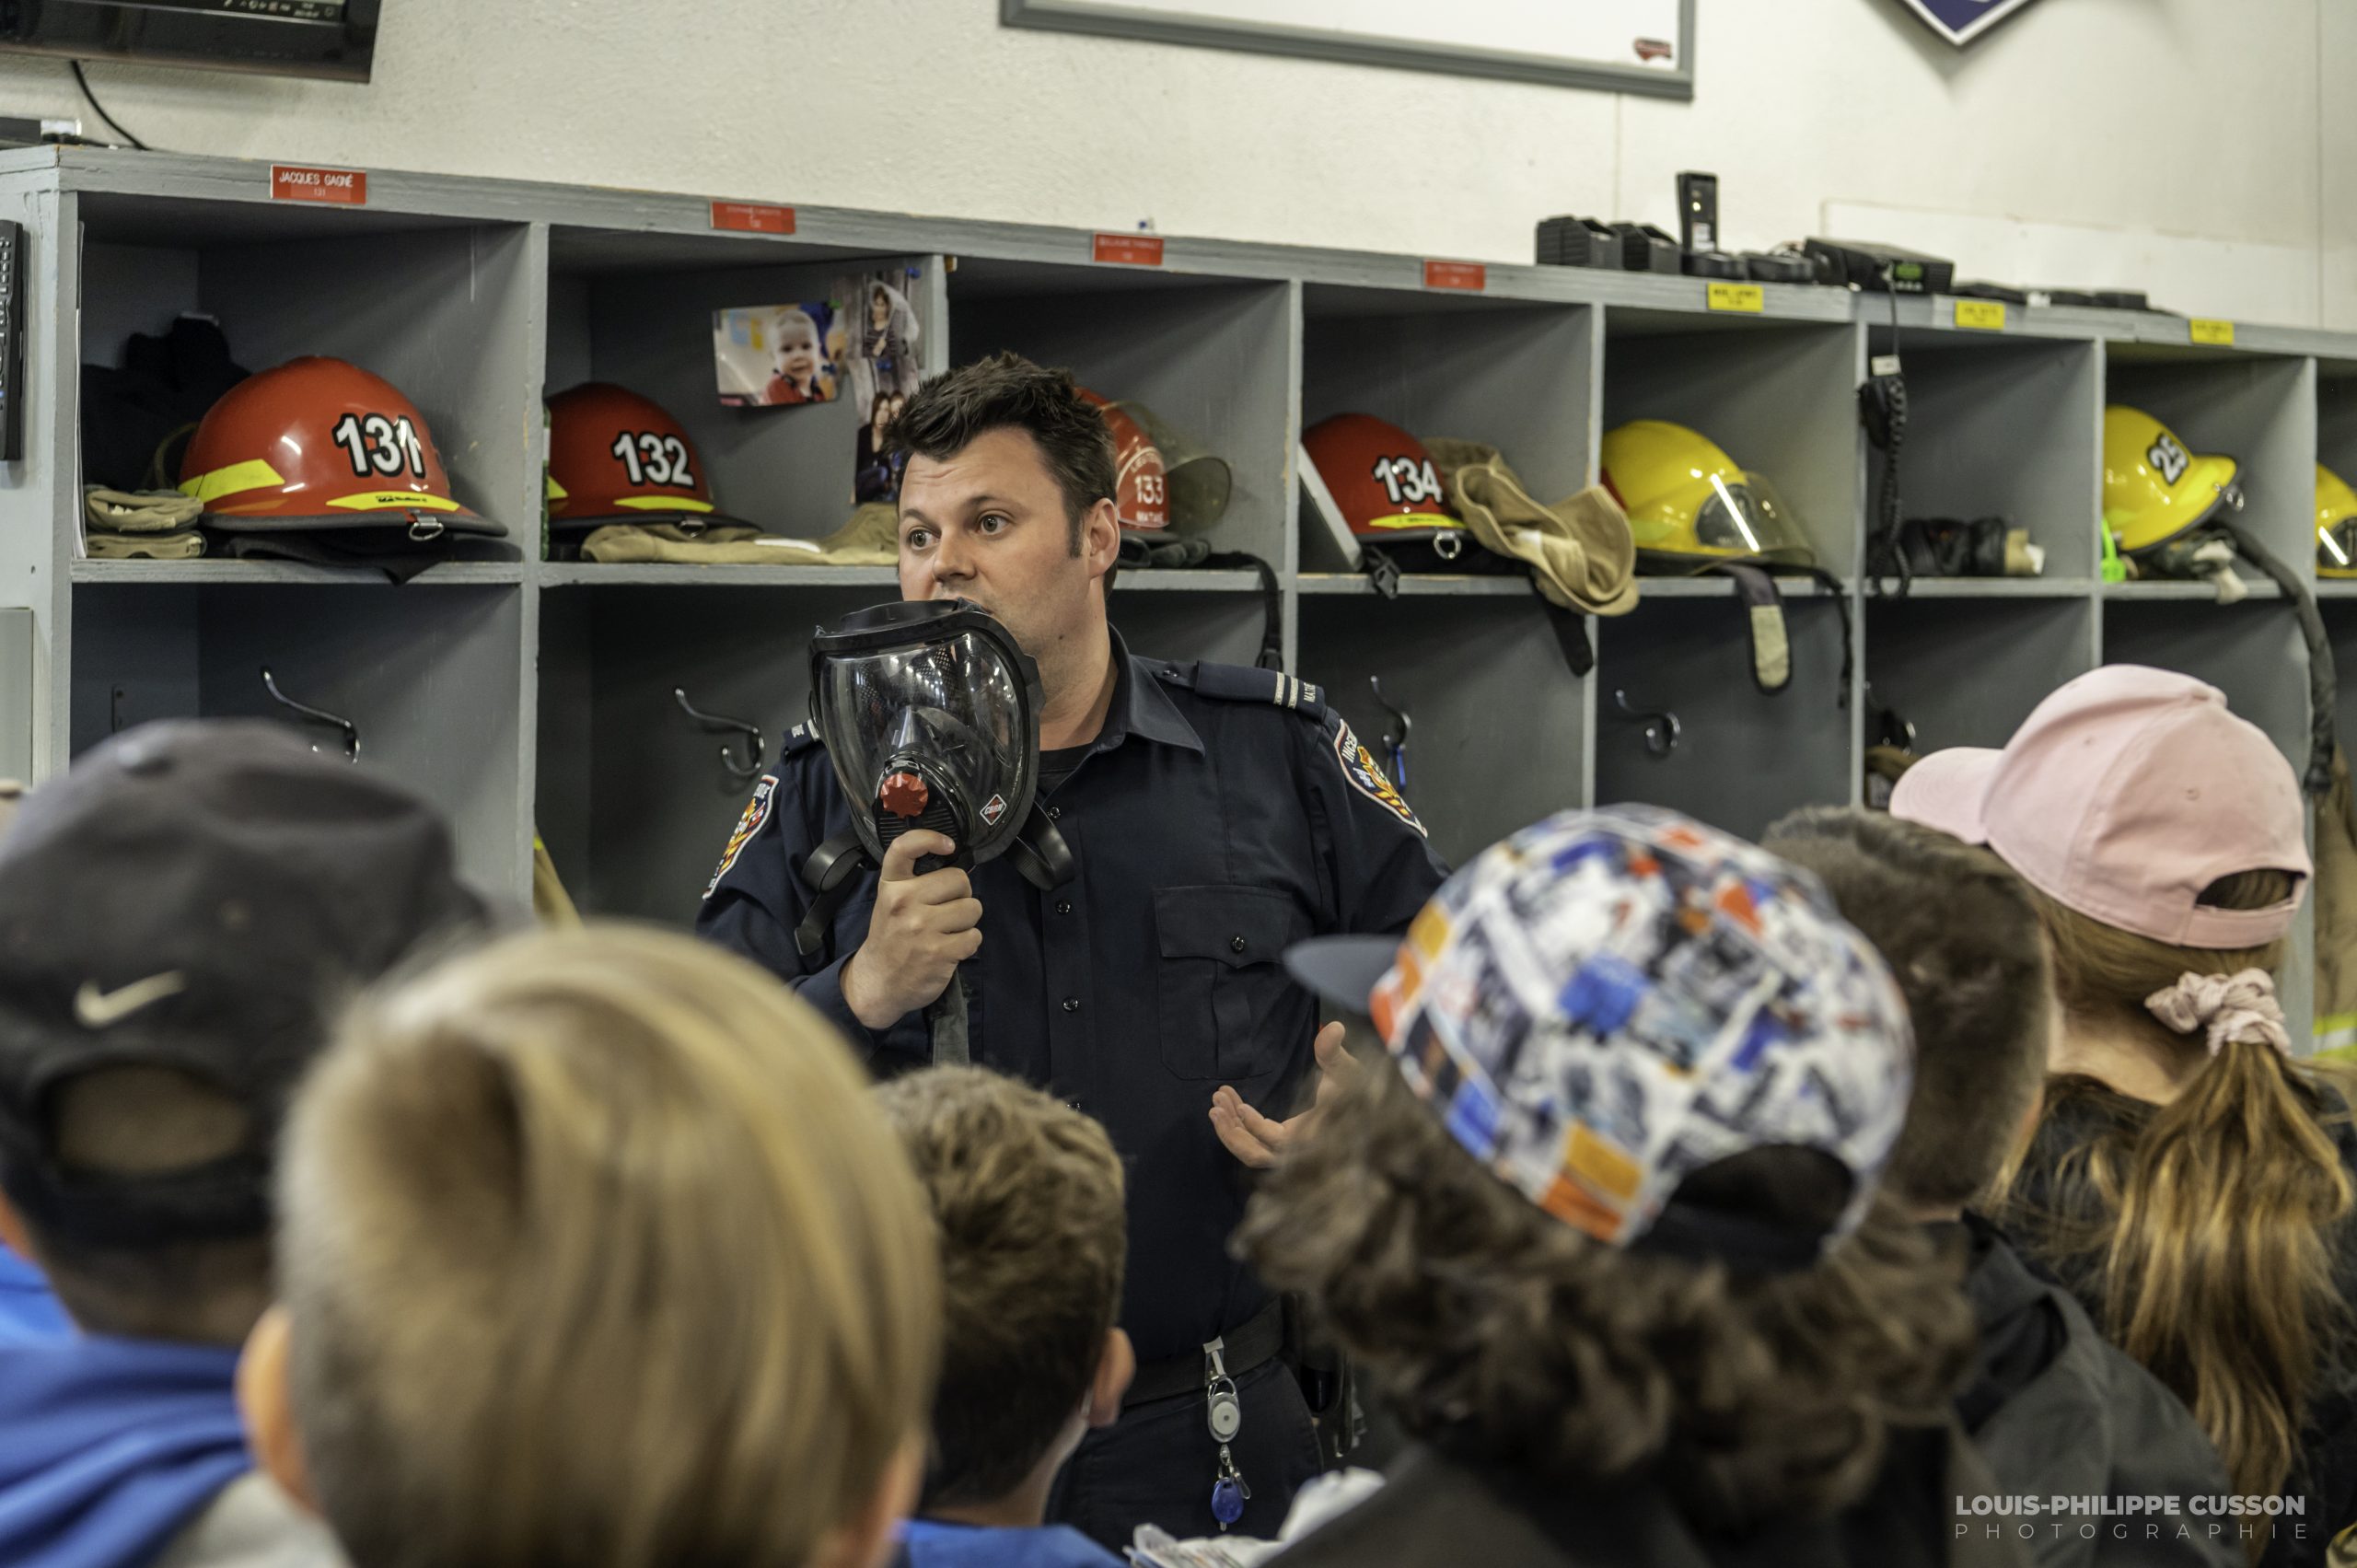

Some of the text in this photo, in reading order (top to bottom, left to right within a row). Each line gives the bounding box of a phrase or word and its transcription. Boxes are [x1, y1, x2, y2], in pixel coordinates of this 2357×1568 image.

[279, 170, 321, 186] JACQUES
[333, 414, 425, 478] 131
[612, 431, 696, 487] 132
[2149, 435, 2188, 484] 25
[1134, 474, 1165, 505] 133
[1374, 457, 1443, 504] 134
